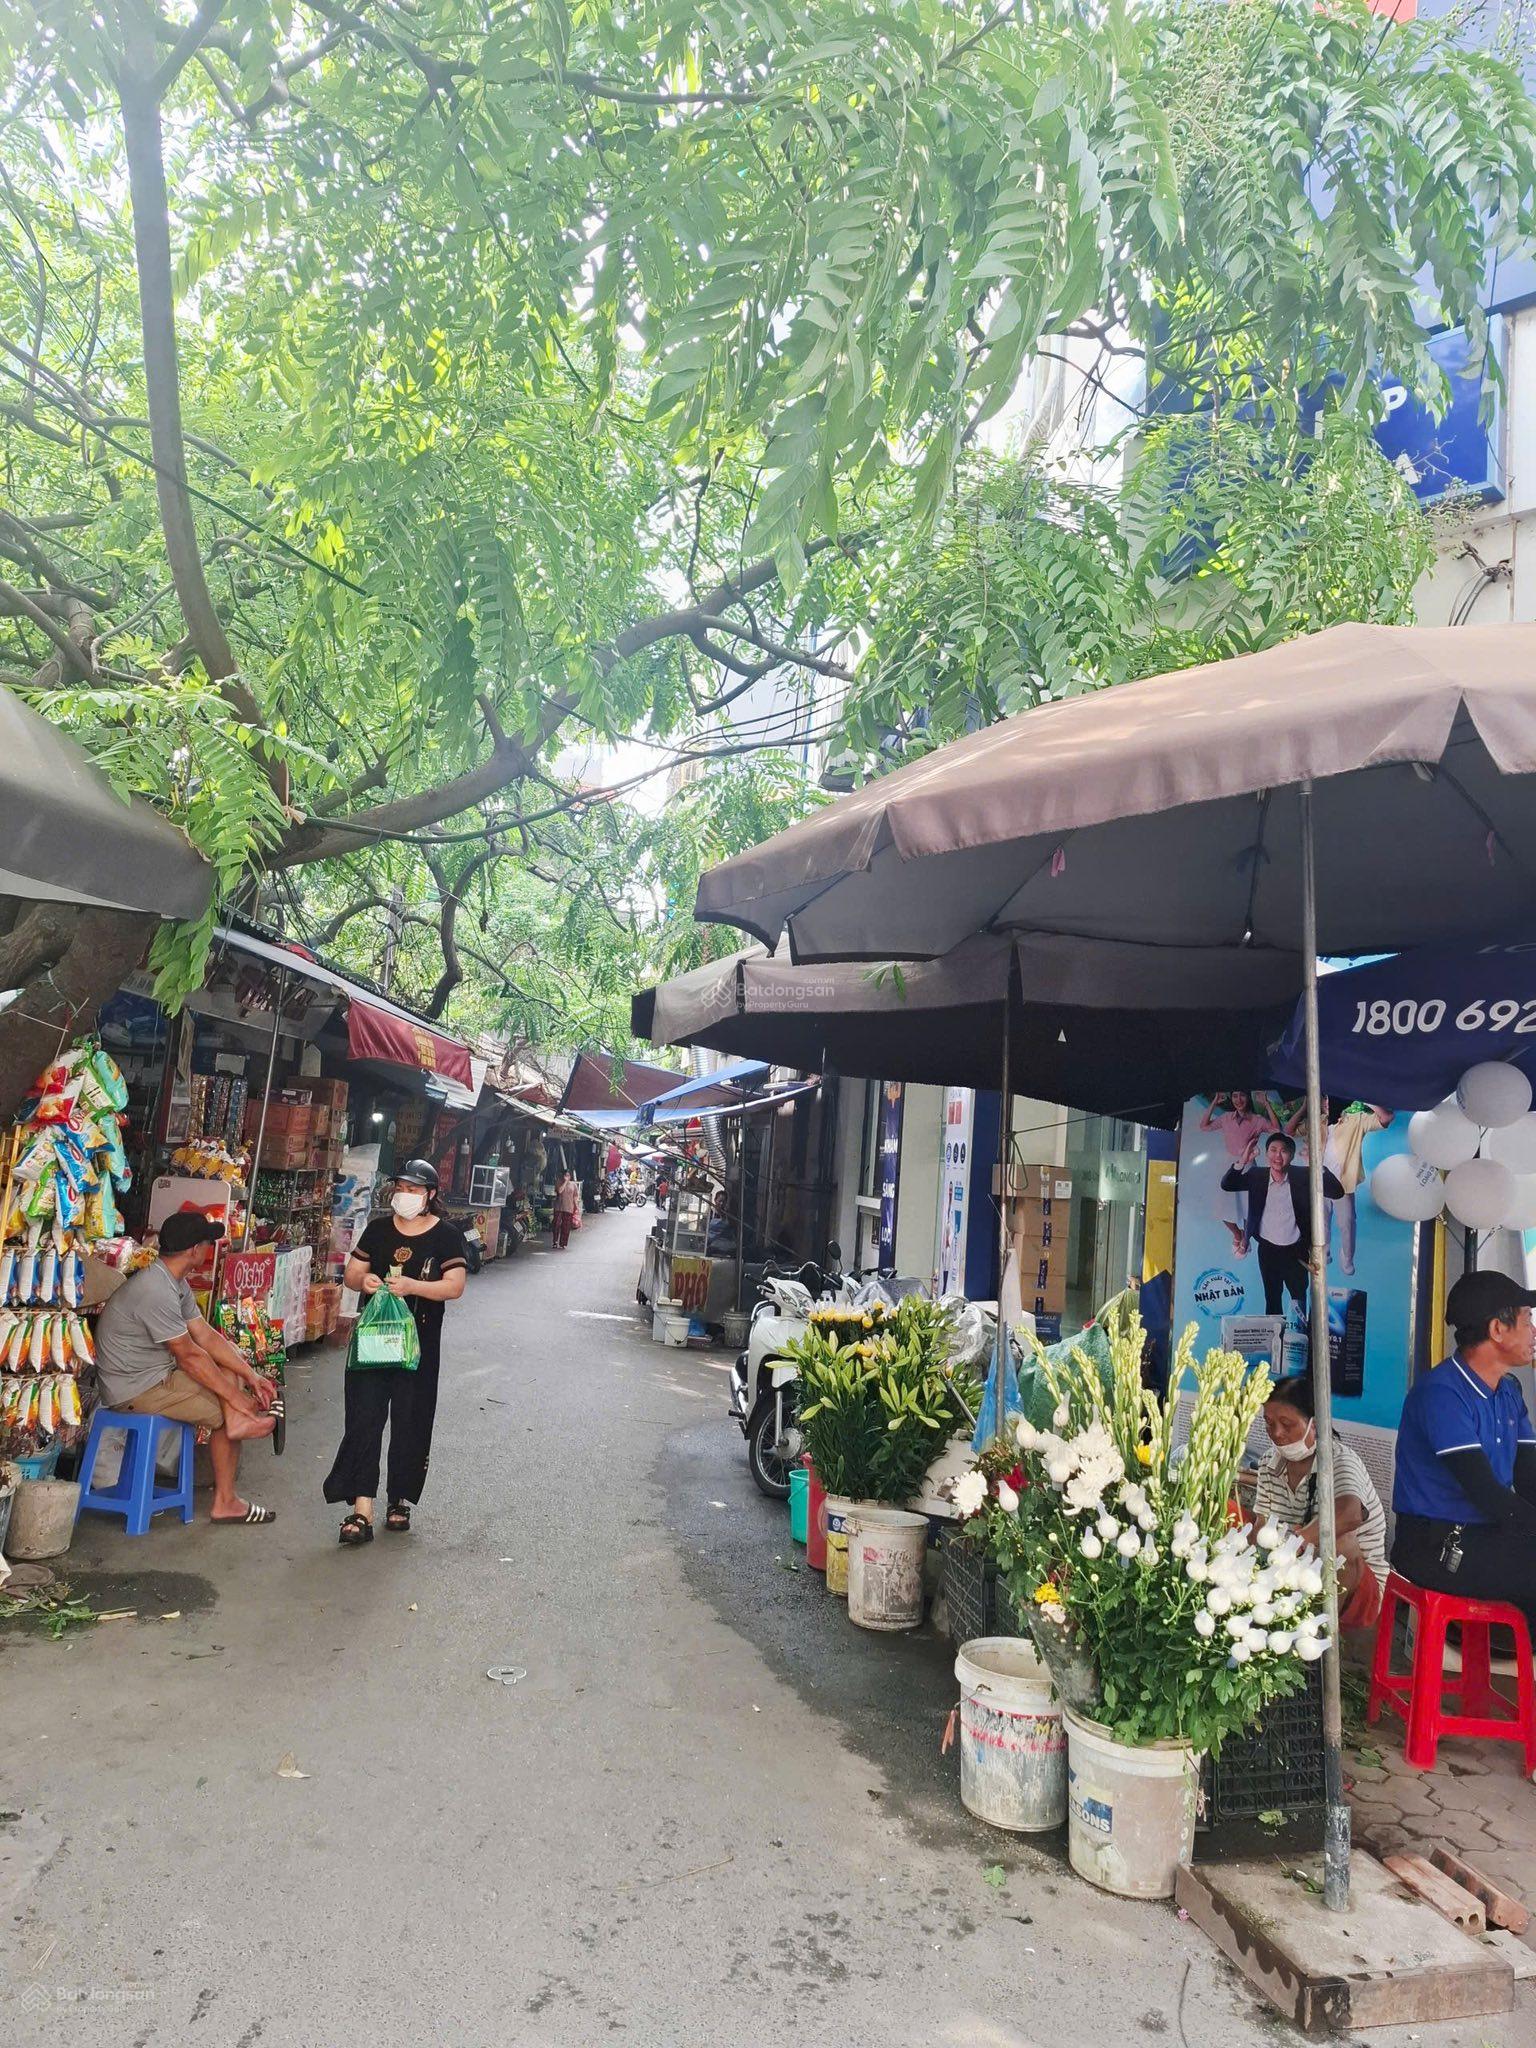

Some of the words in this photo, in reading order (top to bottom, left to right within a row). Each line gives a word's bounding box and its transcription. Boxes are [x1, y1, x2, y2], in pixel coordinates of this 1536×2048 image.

[1352, 1000, 1446, 1035] 1800
[234, 1260, 266, 1289] Oishi
[1194, 1289, 1221, 1302] NHẬT
[1223, 1285, 1245, 1297] BẢN
